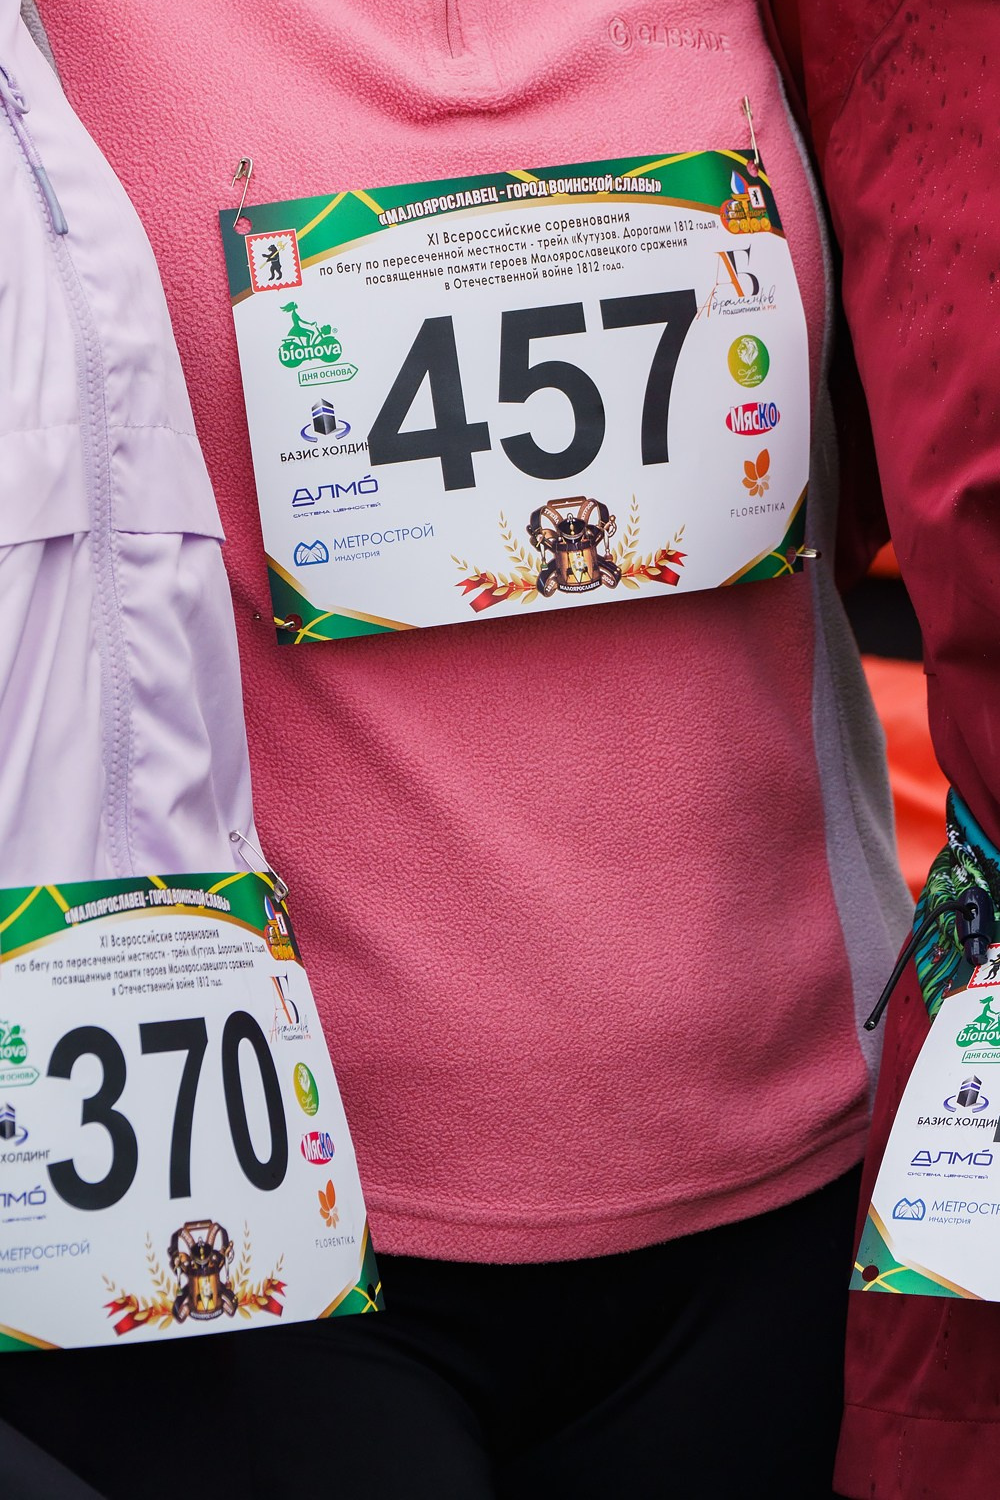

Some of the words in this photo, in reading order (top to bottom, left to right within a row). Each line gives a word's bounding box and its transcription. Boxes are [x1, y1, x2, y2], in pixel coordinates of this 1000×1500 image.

[638, 23, 731, 52] GLISSADE
[378, 186, 499, 226] «МАЛОЯРОСЛАВЕЦ
[506, 179, 549, 200] ГОРОД
[548, 174, 613, 194] ВОИНСКОЙ
[613, 176, 662, 193] СЛАВЫ»
[443, 221, 541, 244] Всероссийские
[545, 212, 630, 234] соревнования
[319, 265, 333, 276] по
[337, 261, 362, 274] бегу
[366, 259, 379, 270] по
[383, 248, 464, 269] пересеченной
[467, 242, 527, 257] местности
[537, 235, 569, 251] трейл
[571, 230, 620, 246] «Кутузов.
[622, 225, 672, 240] Дорогами
[673, 220, 694, 233] 1812
[365, 267, 444, 286] посвященные
[447, 262, 487, 276] памяти
[490, 257, 527, 272] героев
[530, 244, 638, 265] Малоярославецкого
[640, 237, 688, 253] сражения
[444, 281, 450, 290] в
[453, 268, 539, 289] Отечественной
[542, 264, 573, 278] войне
[576, 261, 600, 275] 1812
[602, 263, 625, 273] года.
[280, 343, 341, 362] bionova
[301, 370, 319, 382] ДНЯ
[320, 367, 353, 379] ОСНОВА
[367, 289, 698, 491] 457
[280, 447, 320, 463] БАЗИС
[293, 509, 331, 518] СИСТЕМА
[730, 502, 786, 518] FLORENTIKA
[333, 522, 435, 550] МЕТРОСТРОЙ
[334, 550, 381, 562] индустрия
[148, 888, 173, 905] ГОРОД
[110, 930, 172, 949] Всероссийские
[174, 928, 220, 944] соревнования
[15, 963, 26, 973] по
[29, 960, 50, 972] бегу
[52, 959, 64, 969] по
[66, 951, 125, 969] пересеченной
[127, 951, 165, 963] местности
[171, 946, 189, 960] трейл
[52, 971, 111, 986] посвященные
[114, 967, 141, 979] памяти
[143, 966, 167, 979] героев
[118, 979, 175, 996] Отечественной
[176, 977, 195, 990] войне
[196, 976, 209, 988] 1812
[964, 1052, 981, 1060] ДНЯ
[46, 1010, 289, 1211] 370
[917, 1116, 955, 1126] БАЗИС
[0, 1149, 51, 1165] ХОЛДИНГ
[315, 1235, 356, 1249] FLORENTIKA
